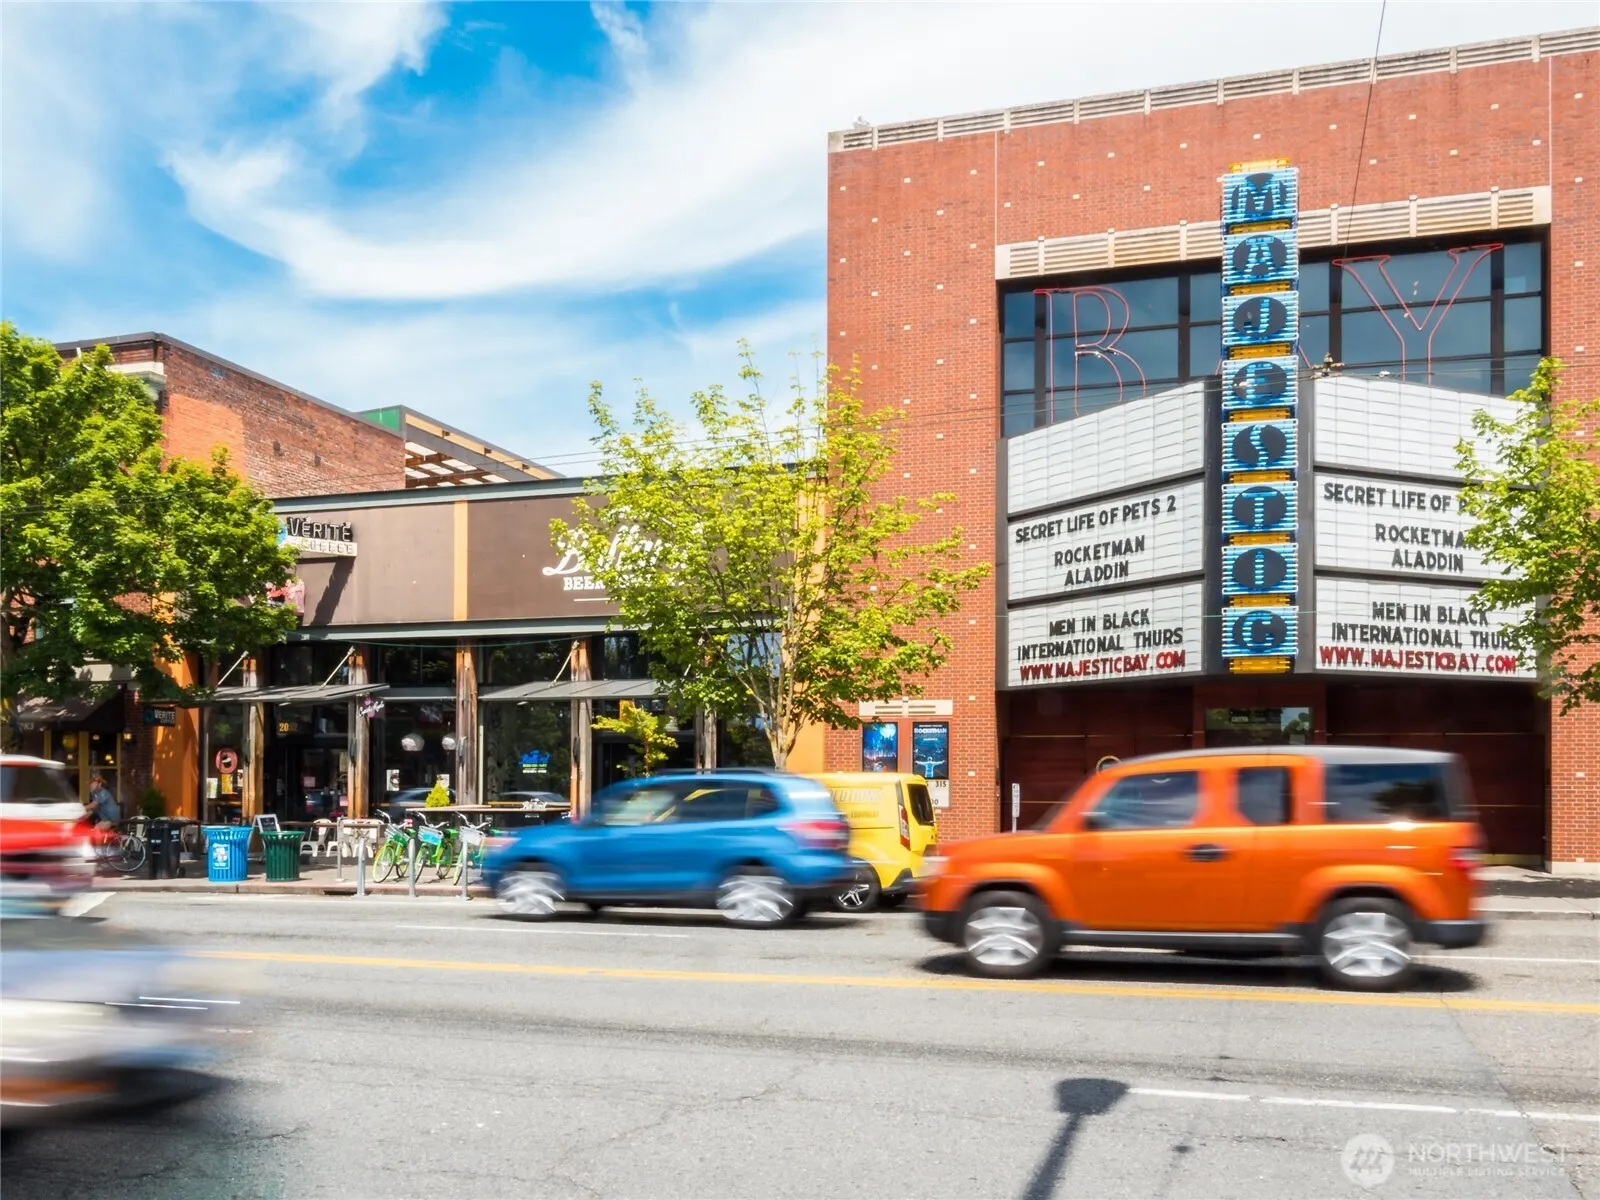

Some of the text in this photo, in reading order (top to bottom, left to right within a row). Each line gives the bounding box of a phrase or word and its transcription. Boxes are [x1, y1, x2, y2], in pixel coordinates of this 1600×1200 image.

[1233, 171, 1286, 652] MAJESTIC
[1323, 482, 1386, 507] SECRET
[1391, 489, 1426, 511] LIFE
[1430, 493, 1451, 513] OF
[1015, 494, 1177, 544] SECRET LIFE OF PETS 2
[1054, 535, 1146, 567] ROCKETMAN
[1391, 548, 1464, 573] ALADDIN
[1064, 560, 1129, 586] ALADDIN
[1049, 608, 1150, 638] MEN IN BLACK
[1372, 601, 1489, 627] MEN IN BLACK
[1017, 627, 1183, 661] INTERNATIONAL THURS
[1331, 622, 1518, 650] INTERNATIONAL THUR
[1319, 645, 1517, 674] WWW.MAJESTICBAY.COM
